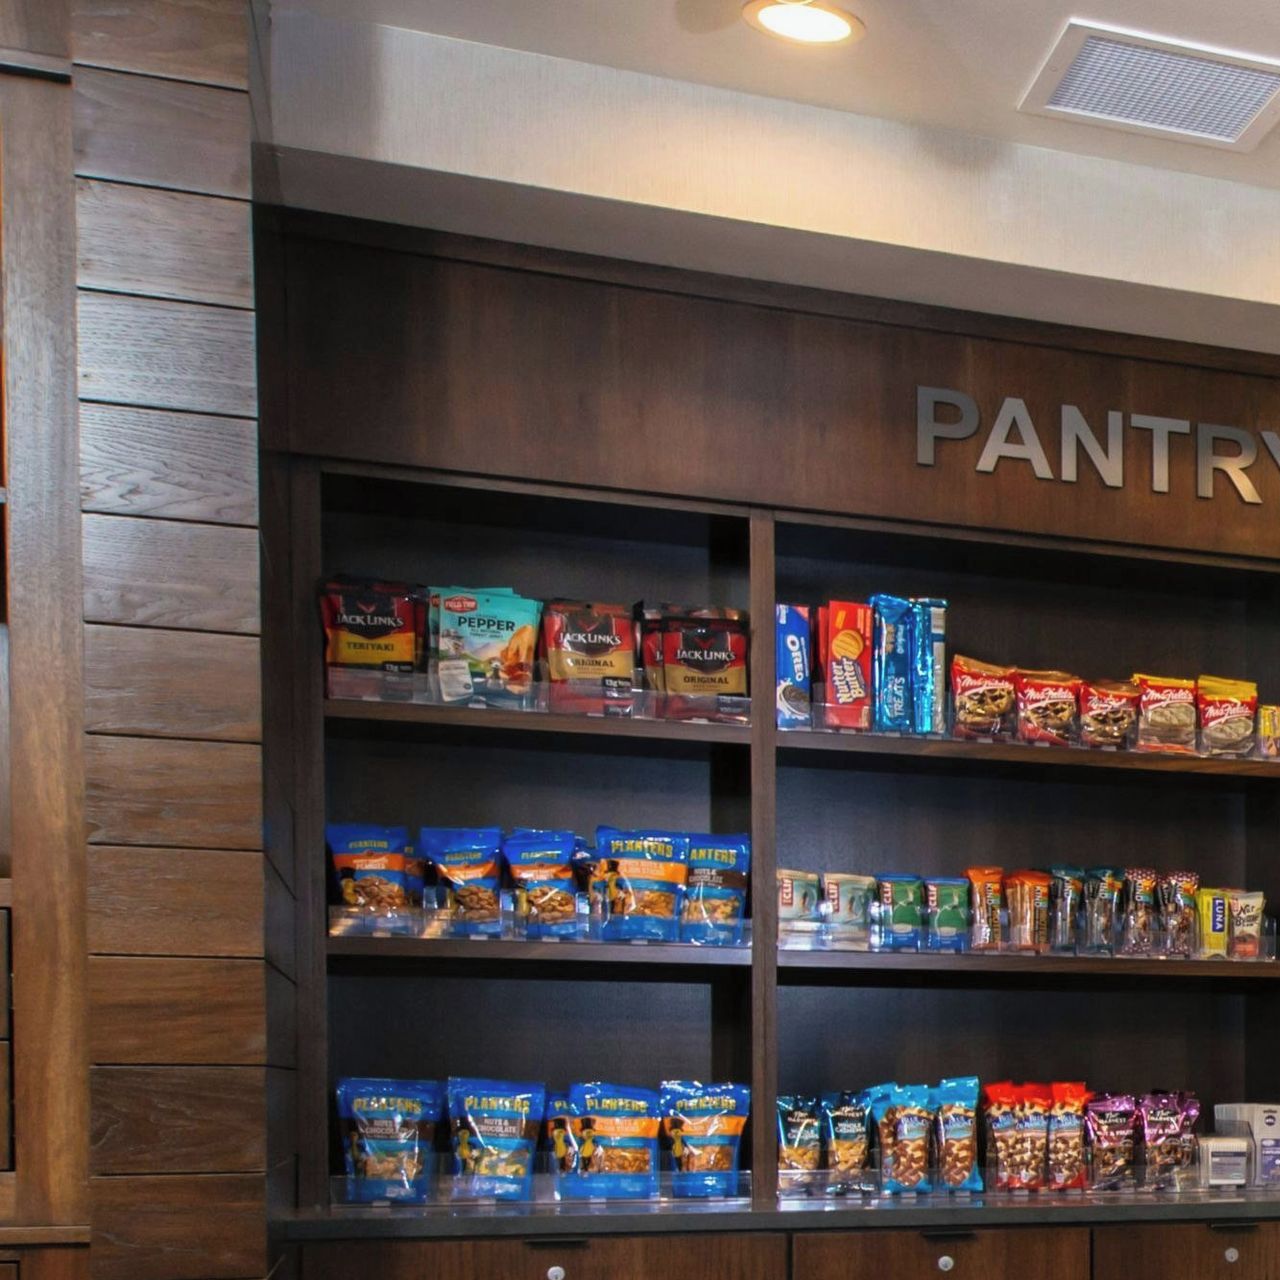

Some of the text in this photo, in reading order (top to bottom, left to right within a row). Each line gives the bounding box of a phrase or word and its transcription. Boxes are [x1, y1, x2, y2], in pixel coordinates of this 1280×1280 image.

[458, 616, 516, 632] PEPPER
[347, 641, 394, 652] TERIYAKI
[676, 649, 703, 661] JACK
[570, 659, 615, 668] RIGINAL
[786, 634, 804, 682] OREO
[683, 676, 730, 685] ORIGINAL
[832, 661, 852, 704] Nutter
[843, 657, 865, 700] Butter
[894, 676, 905, 716] TREATS
[690, 848, 737, 866] ANTERS
[1215, 899, 1224, 930] LUNA
